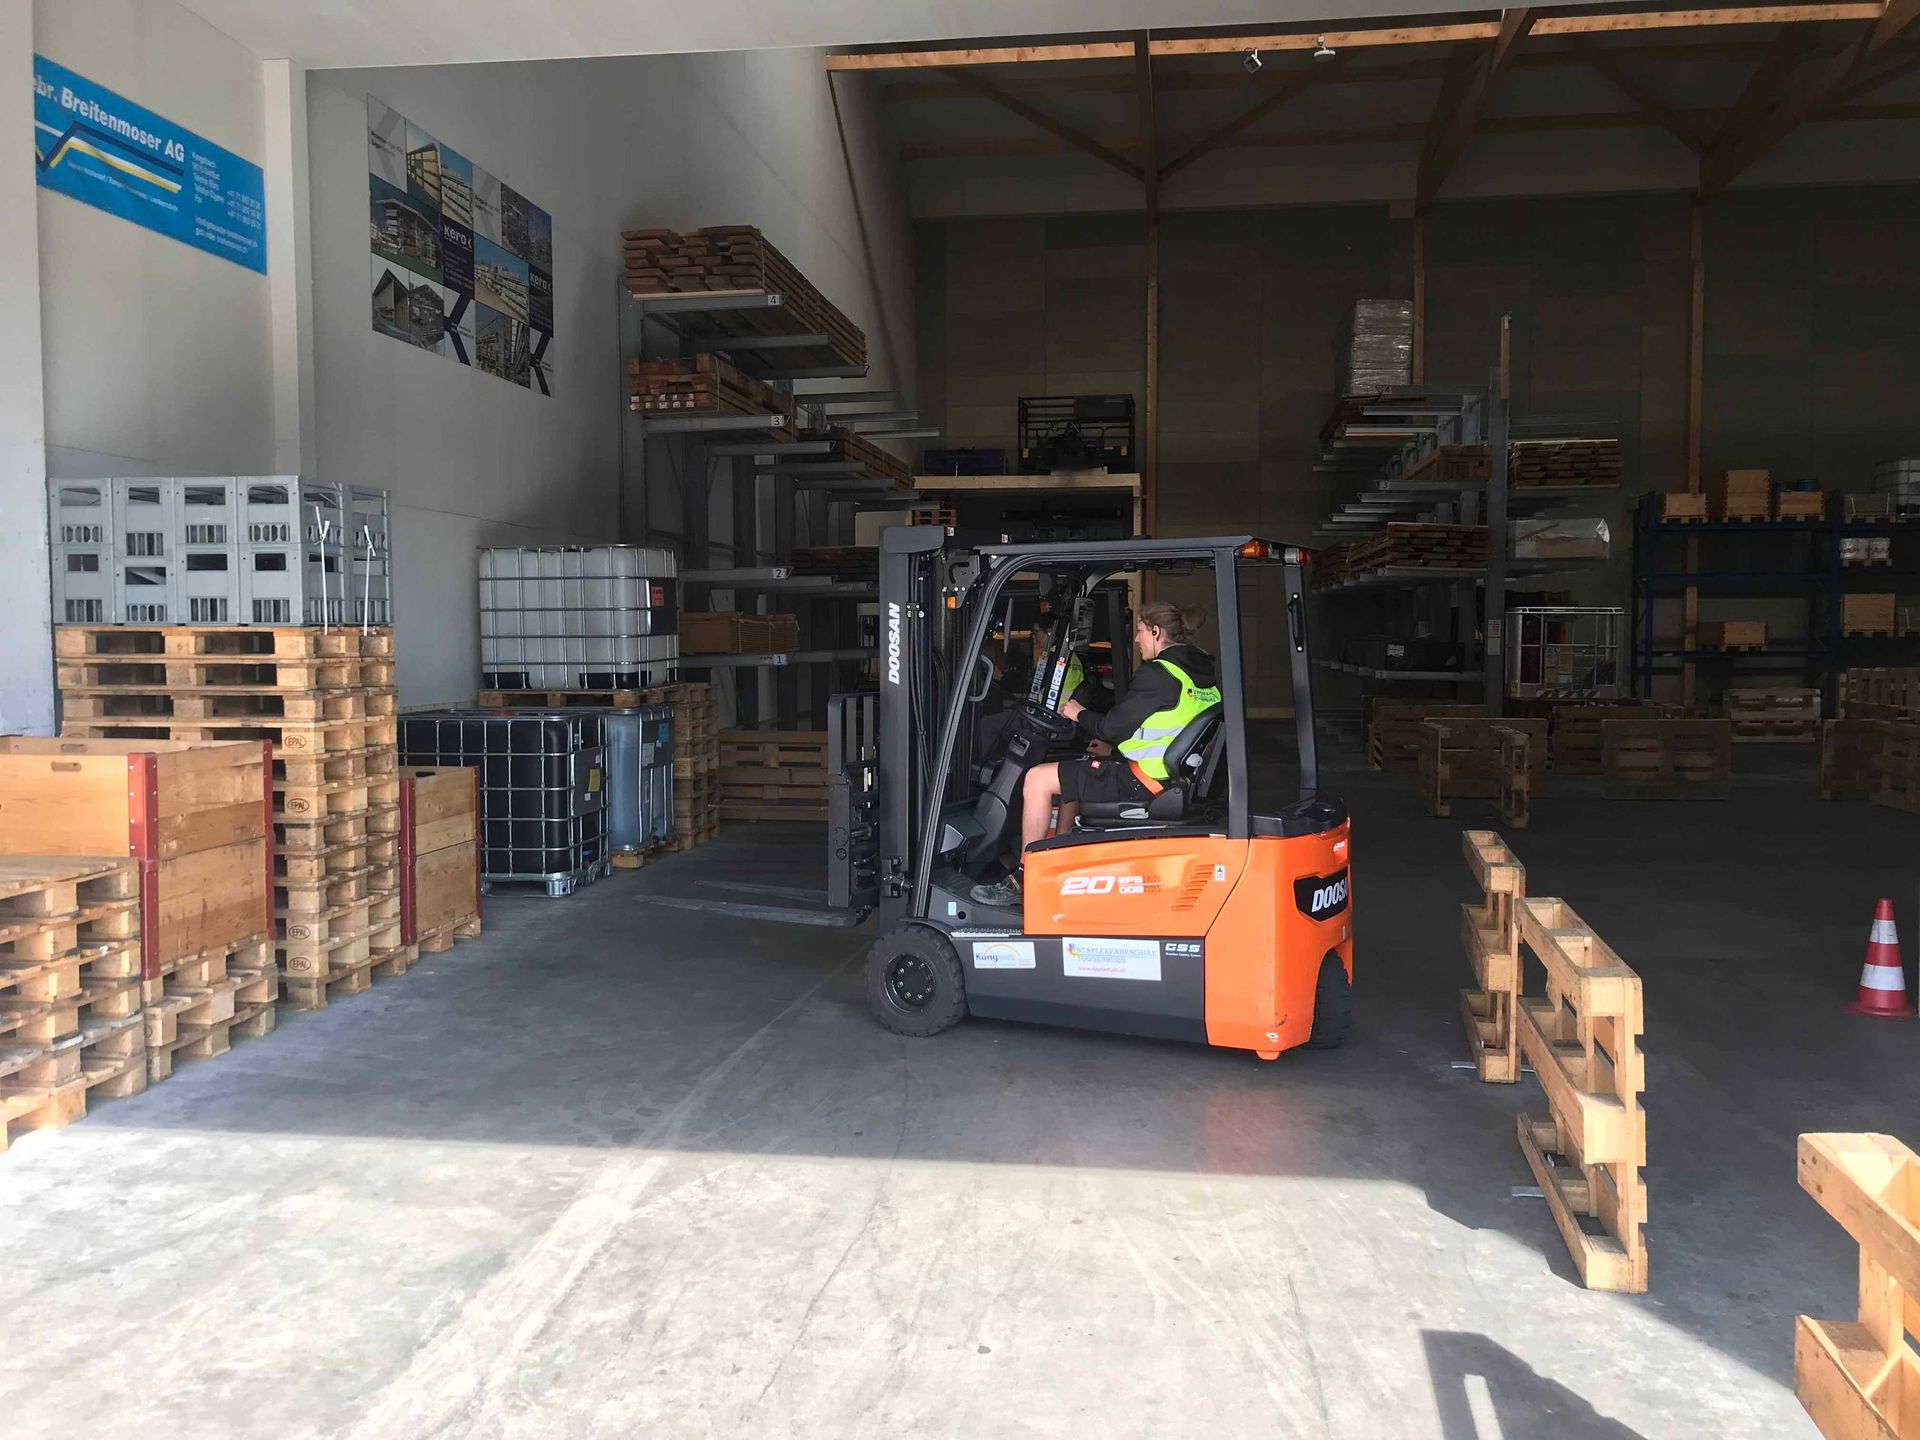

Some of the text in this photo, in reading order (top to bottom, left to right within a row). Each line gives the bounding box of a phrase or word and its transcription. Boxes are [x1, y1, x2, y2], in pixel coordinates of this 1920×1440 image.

[61, 86, 162, 150] Breitenmoser
[164, 139, 185, 162] AG
[770, 295, 777, 304] 4
[774, 416, 780, 426] 3
[775, 569, 782, 578] 2
[888, 601, 900, 685] DOOSAN
[1060, 875, 1116, 895] 20
[1165, 943, 1201, 952] GSS
